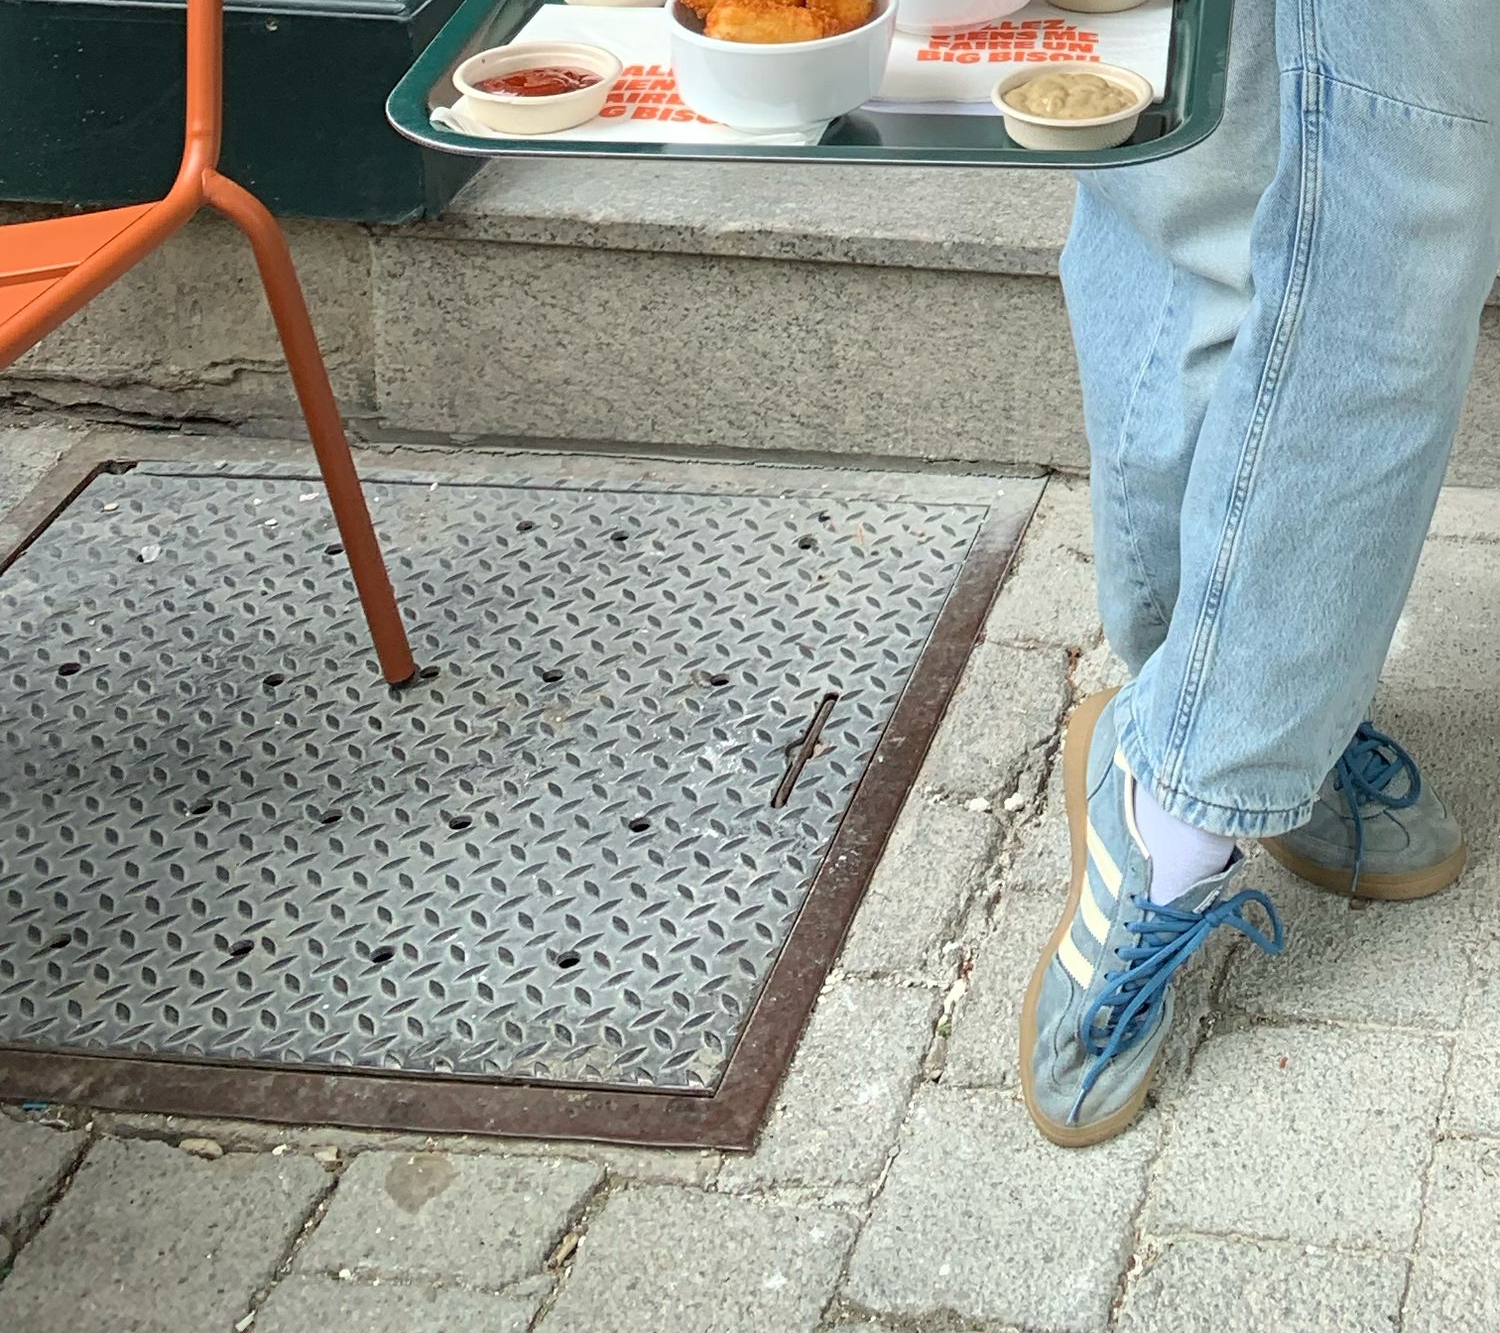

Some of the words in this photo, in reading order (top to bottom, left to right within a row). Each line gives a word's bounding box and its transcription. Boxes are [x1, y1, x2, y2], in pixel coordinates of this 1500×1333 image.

[1043, 31, 1099, 43] ME
[929, 41, 1035, 51] FAIRE
[1042, 41, 1093, 53] UN
[917, 50, 981, 64] BIG
